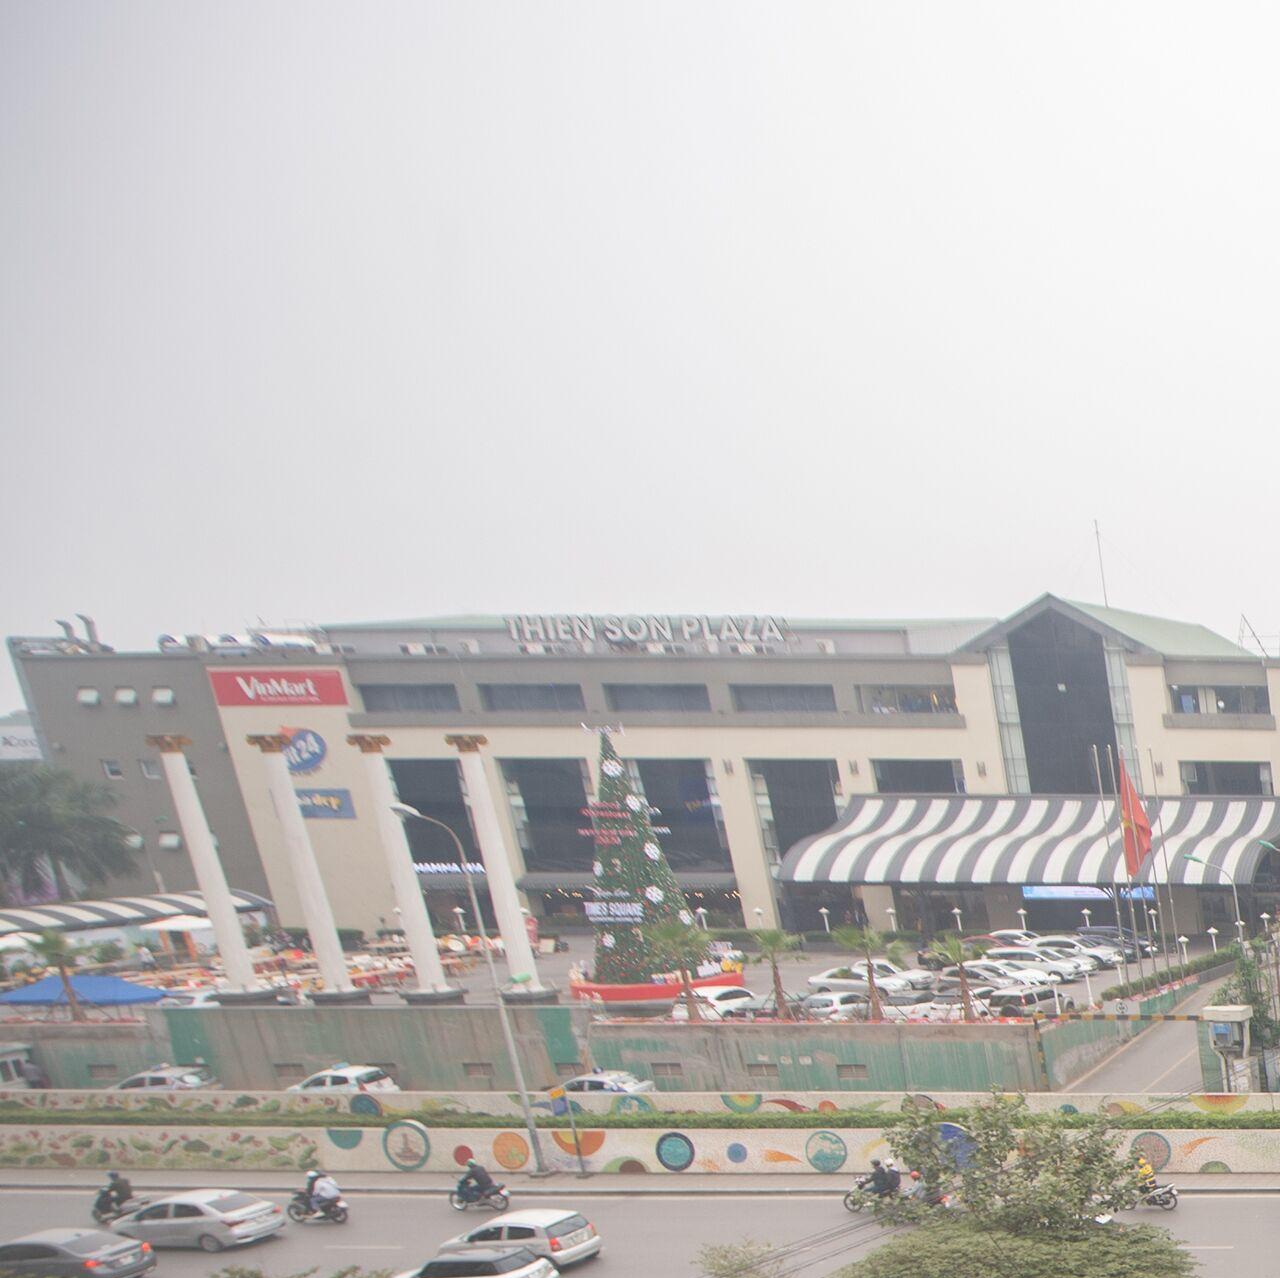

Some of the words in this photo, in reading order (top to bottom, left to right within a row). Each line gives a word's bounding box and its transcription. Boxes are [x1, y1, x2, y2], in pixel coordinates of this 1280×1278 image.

[503, 615, 594, 641] THIEN
[605, 615, 672, 642] SON
[680, 615, 786, 642] PLAZA
[236, 676, 319, 699] VinMart
